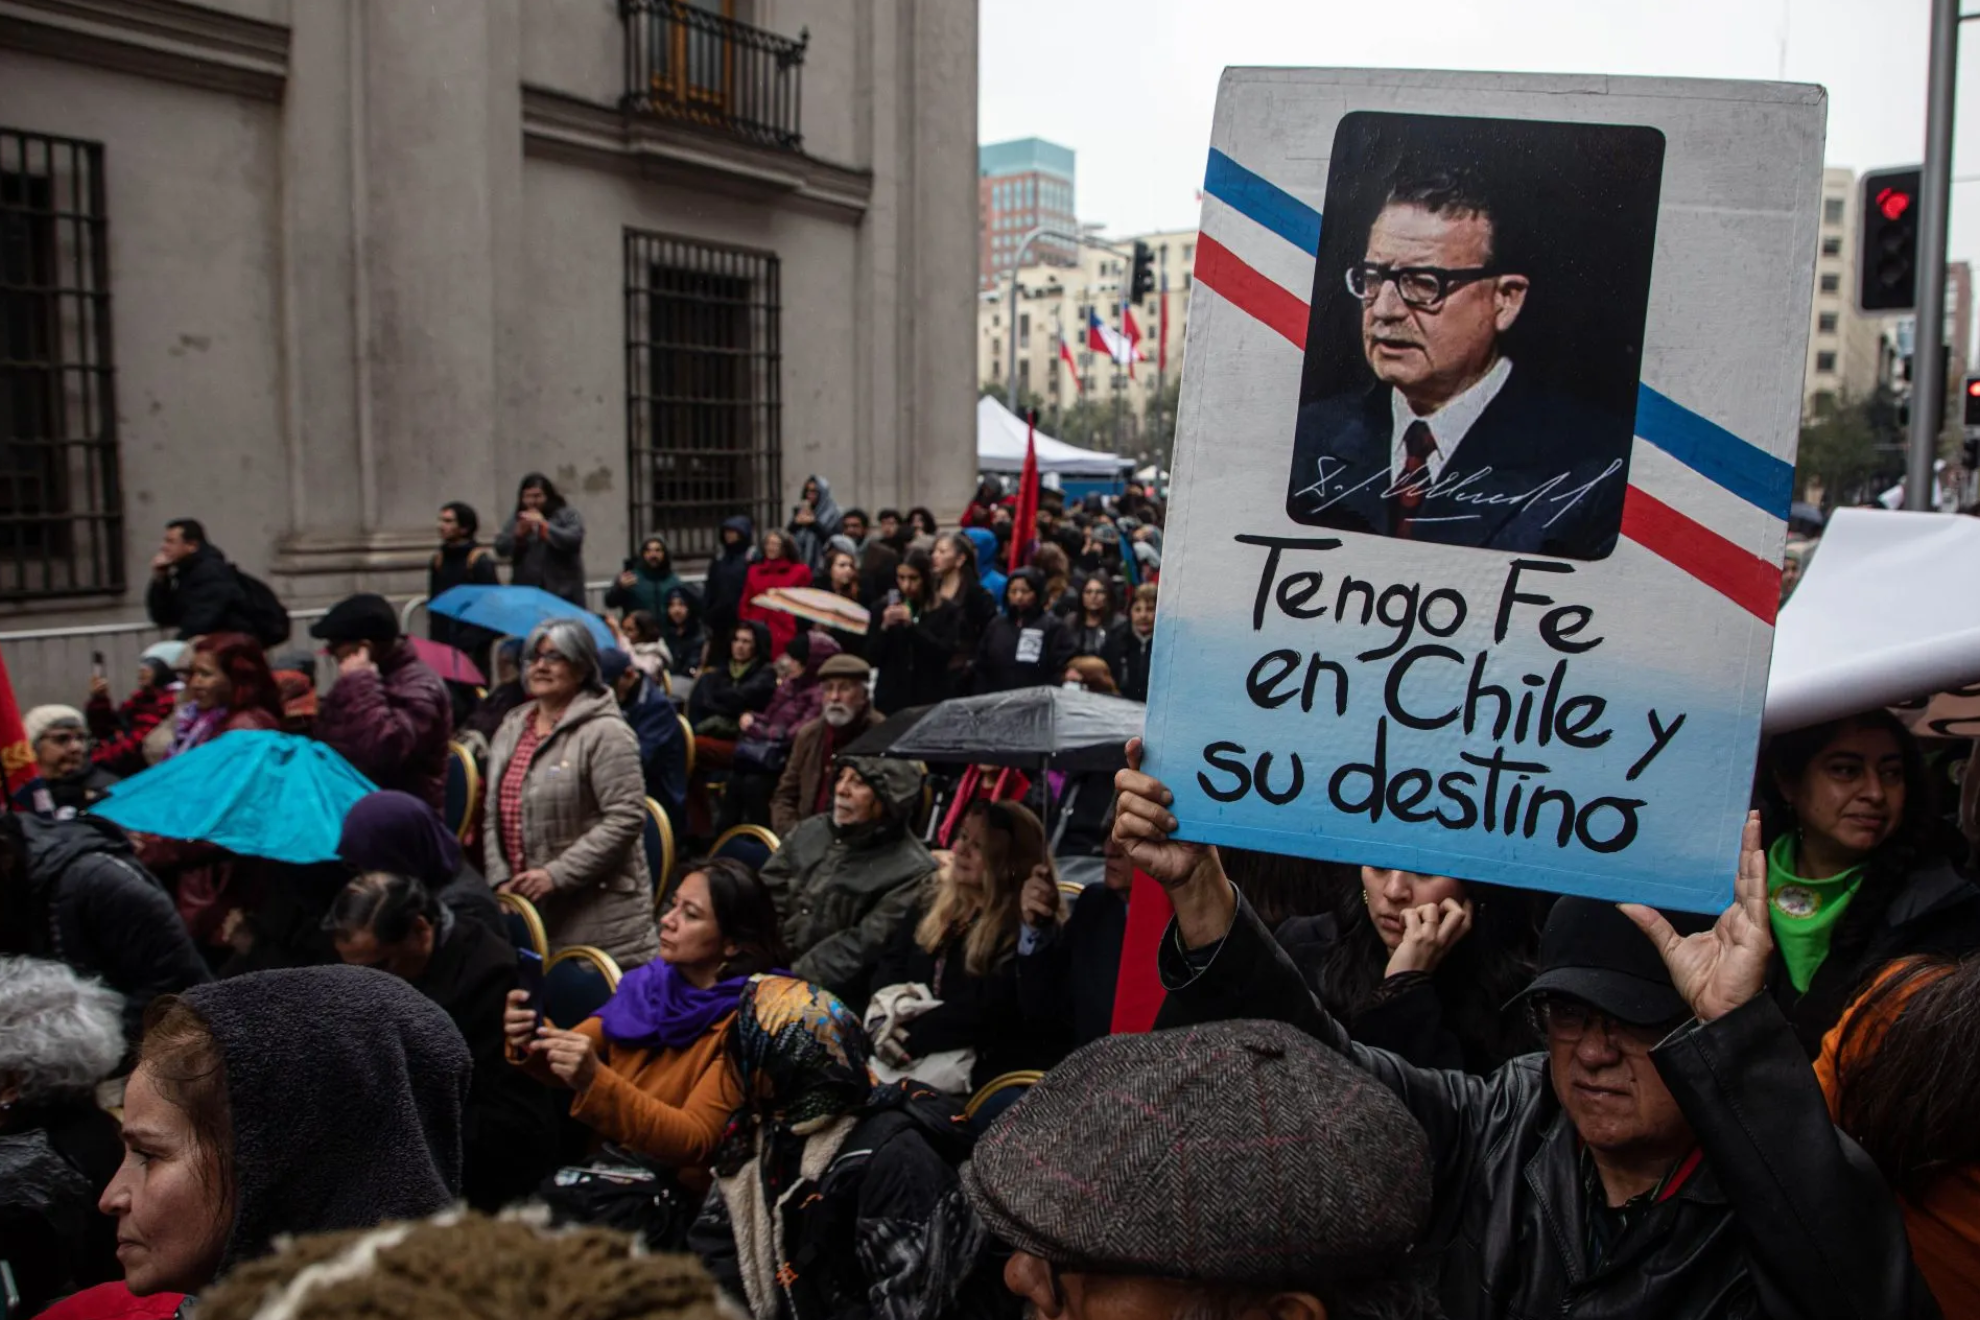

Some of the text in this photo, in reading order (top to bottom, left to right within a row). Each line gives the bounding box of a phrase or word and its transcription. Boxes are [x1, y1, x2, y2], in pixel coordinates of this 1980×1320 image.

[1234, 534, 1605, 664] Tengo Fe
[1245, 643, 1687, 782] en Chile y
[1196, 715, 1650, 855] su destino
